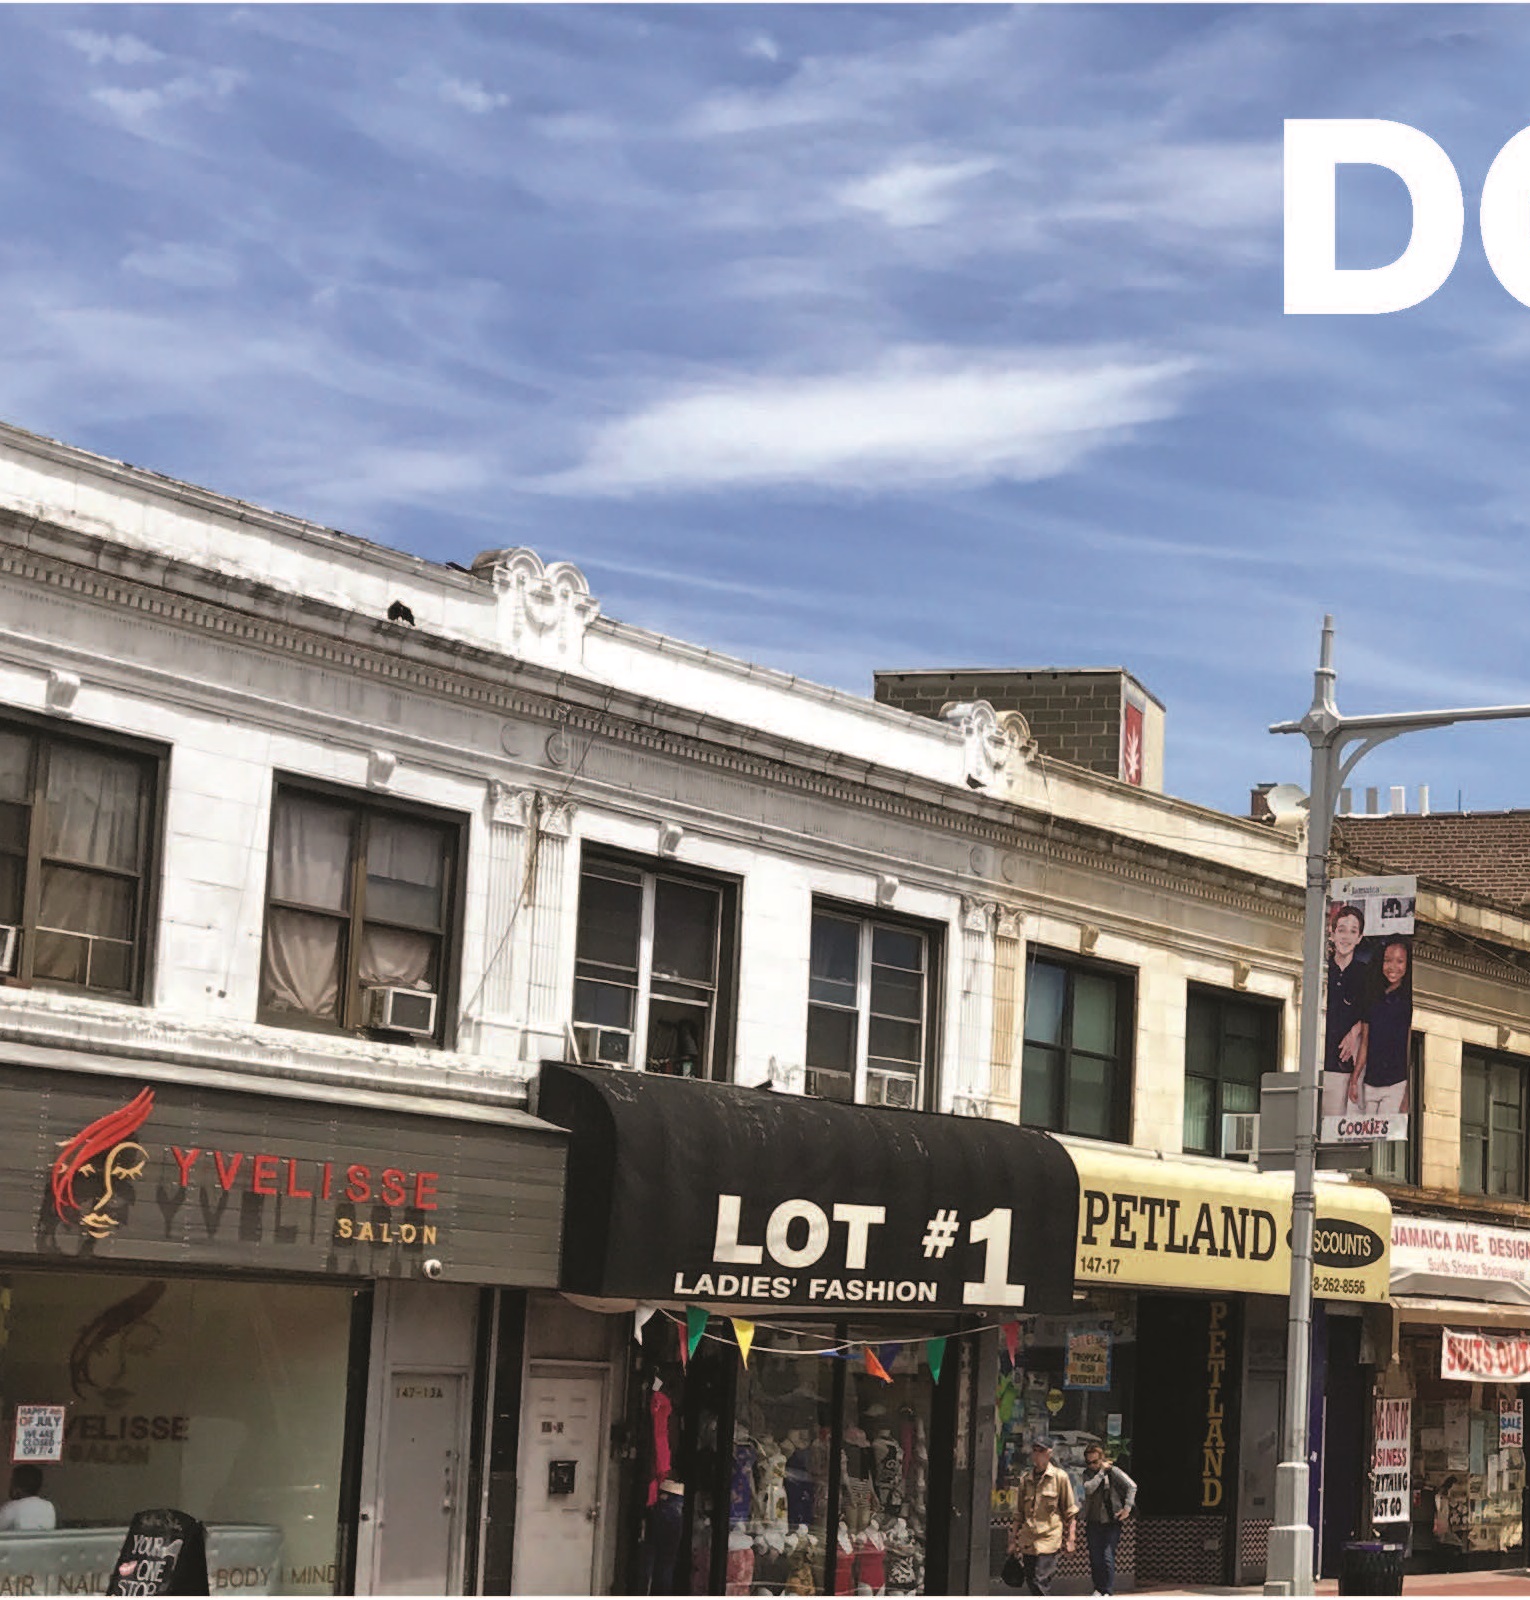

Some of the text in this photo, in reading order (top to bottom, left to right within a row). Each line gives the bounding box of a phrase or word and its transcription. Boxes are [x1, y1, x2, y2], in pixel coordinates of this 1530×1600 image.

[170, 1145, 440, 1211] YVELISSE
[337, 1216, 437, 1246] SALON
[1081, 1189, 1278, 1262] PETLAND
[1390, 1225, 1452, 1253] JAMAICA
[1455, 1233, 1485, 1254] AVE.
[712, 1193, 1026, 1307] LOT #1
[1312, 1229, 1372, 1258] SCOUNTS
[1080, 1256, 1120, 1275] 147-17
[673, 1271, 939, 1303] LADIES' FASHION
[1447, 1336, 1494, 1374] SUITS
[1201, 1301, 1228, 1507] PETLAND
[1500, 1400, 1522, 1414] SALE
[35, 1415, 62, 1427] JULY
[1500, 1416, 1522, 1430] SALE
[1500, 1432, 1522, 1445] SALE
[131, 1534, 164, 1556] YOUR
[136, 1559, 167, 1583] ONE
[215, 1566, 272, 1590] BODY
